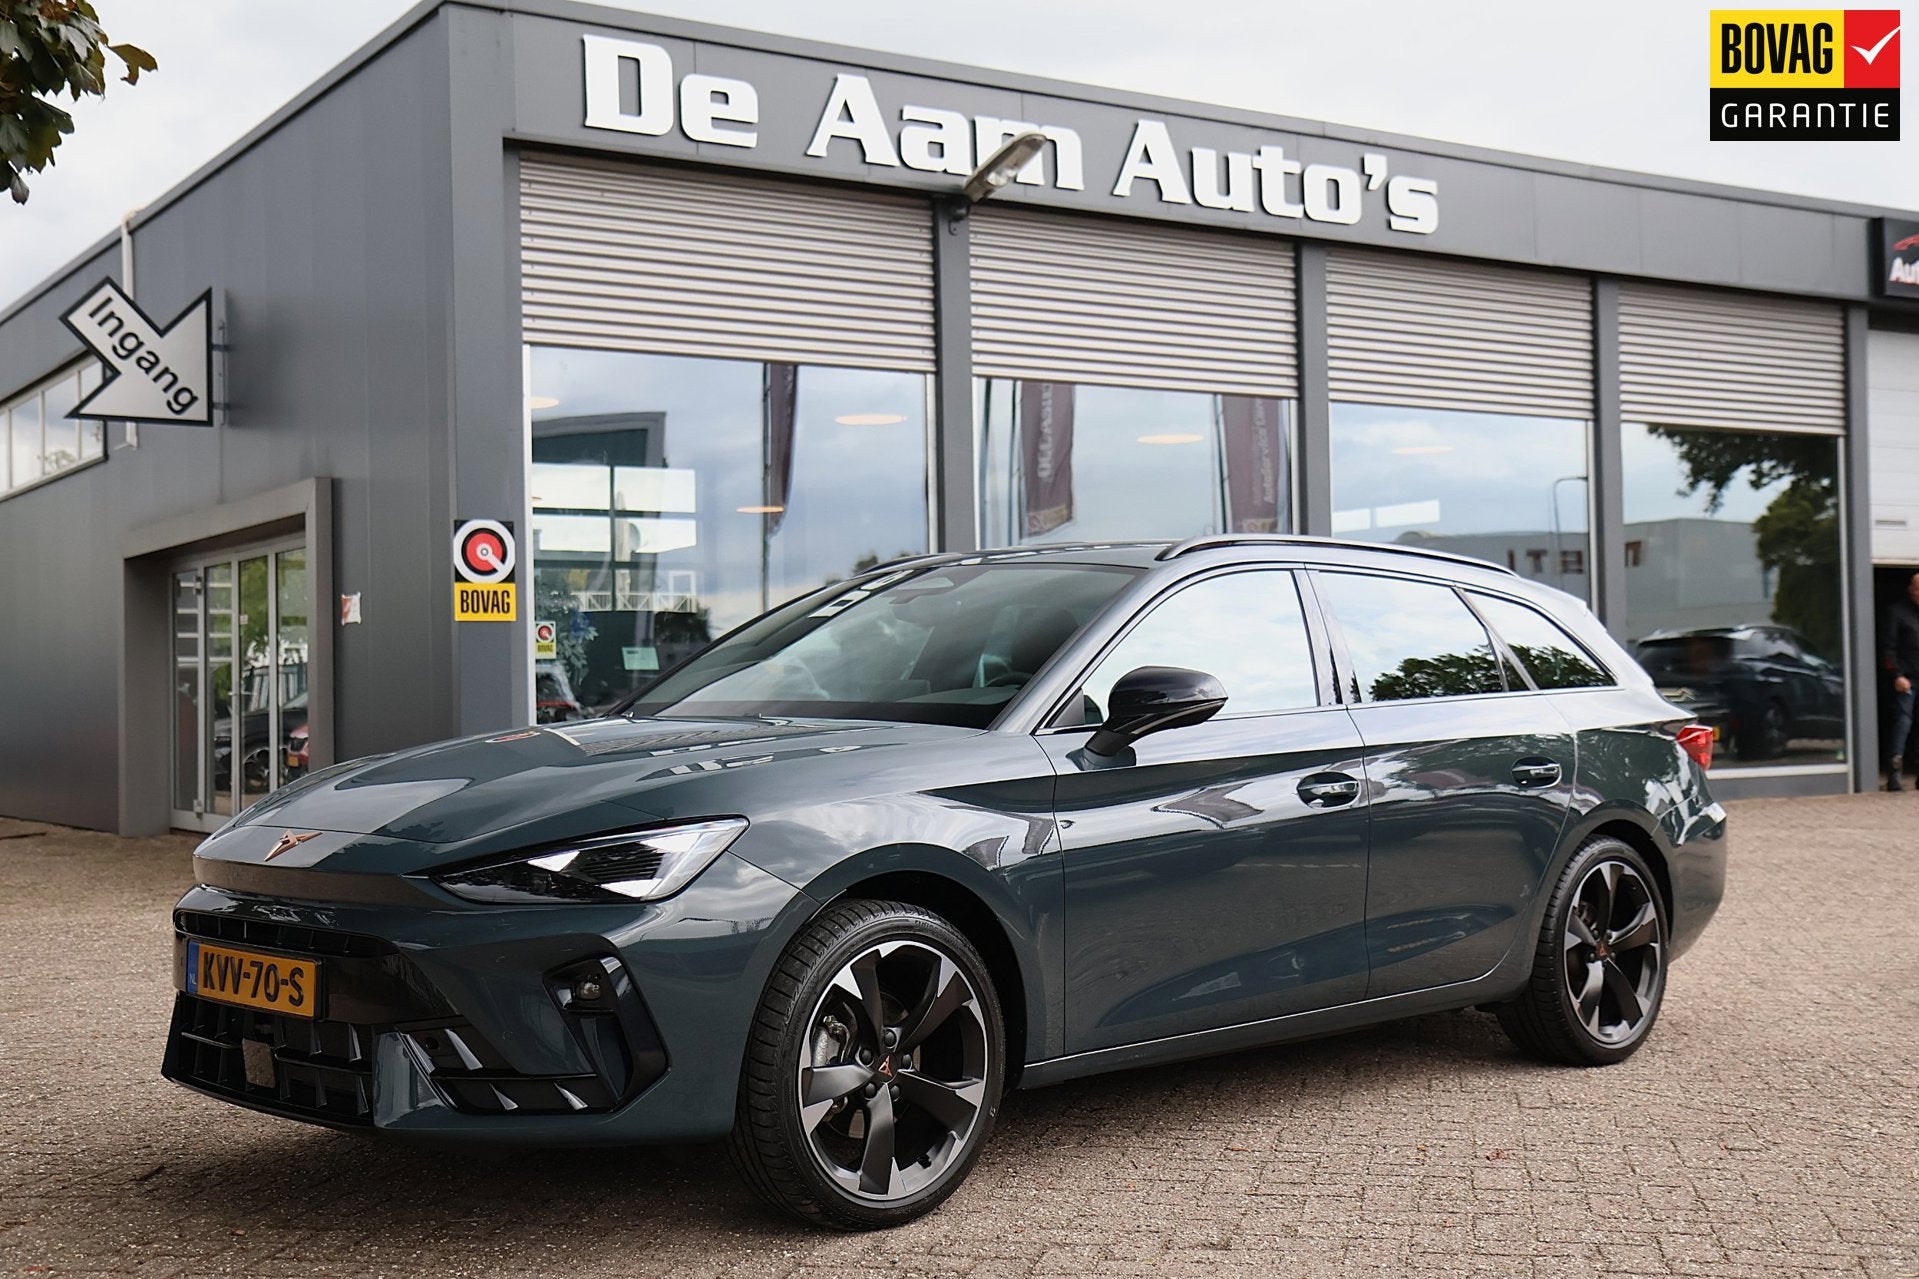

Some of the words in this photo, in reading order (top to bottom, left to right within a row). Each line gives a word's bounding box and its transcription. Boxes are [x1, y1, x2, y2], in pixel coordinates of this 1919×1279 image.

[583, 34, 759, 148] De
[806, 73, 1084, 190] Aam
[1113, 119, 1439, 234] Auto's
[88, 296, 199, 415] Ingang
[460, 589, 511, 614] BOVAG
[203, 952, 304, 1007] KVV-70-S
